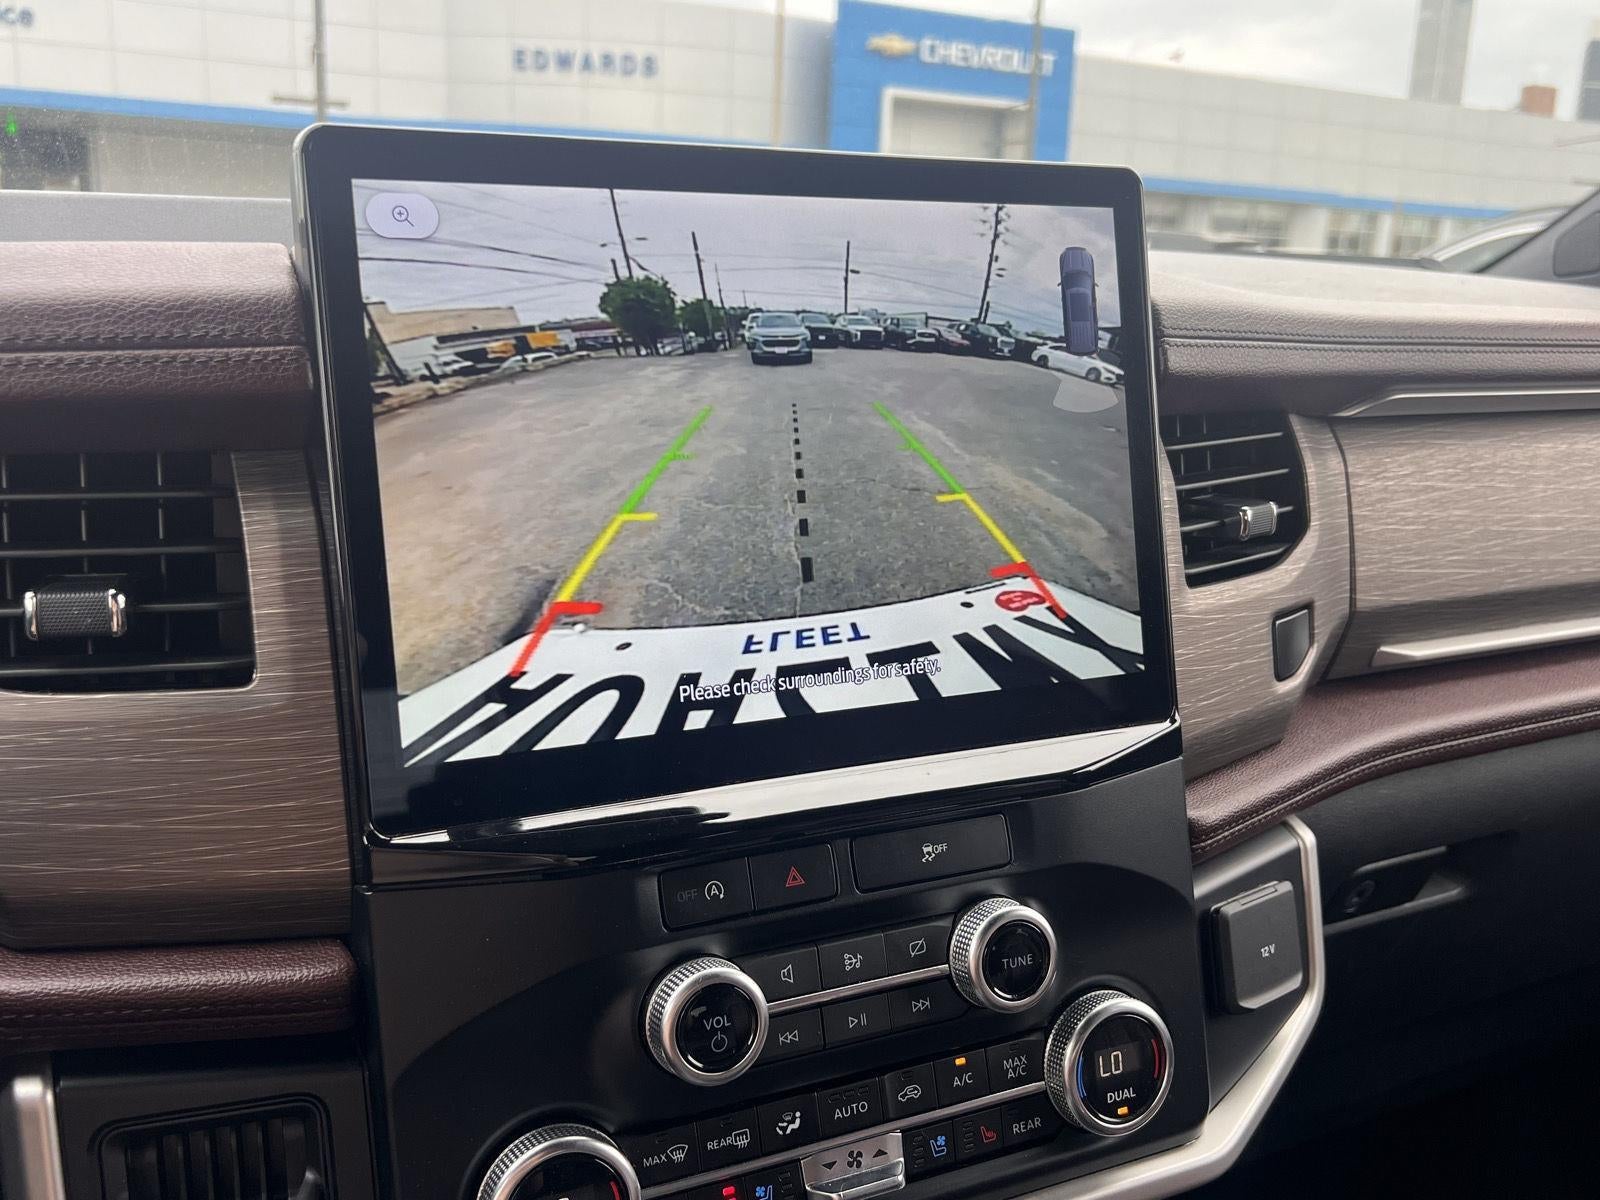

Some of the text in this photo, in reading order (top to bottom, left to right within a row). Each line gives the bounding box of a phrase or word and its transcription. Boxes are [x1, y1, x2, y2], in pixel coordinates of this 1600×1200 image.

[512, 45, 659, 78] EDWARDS
[679, 656, 942, 703] Please check surroundings for safety.
[933, 842, 948, 854] OFF
[676, 888, 698, 903] OFF
[1260, 943, 1276, 958] 12V
[1001, 953, 1033, 969] TUNE
[703, 1014, 732, 1031] VOL
[1003, 1054, 1028, 1070] MAX
[953, 1072, 974, 1087] A/C
[1007, 1064, 1027, 1080] A/C
[1107, 1086, 1137, 1104] DUAL
[834, 1101, 868, 1120] AUTO
[1012, 1117, 1042, 1134] REAR
[707, 1136, 733, 1151] REAR
[643, 1153, 668, 1168] MAX
